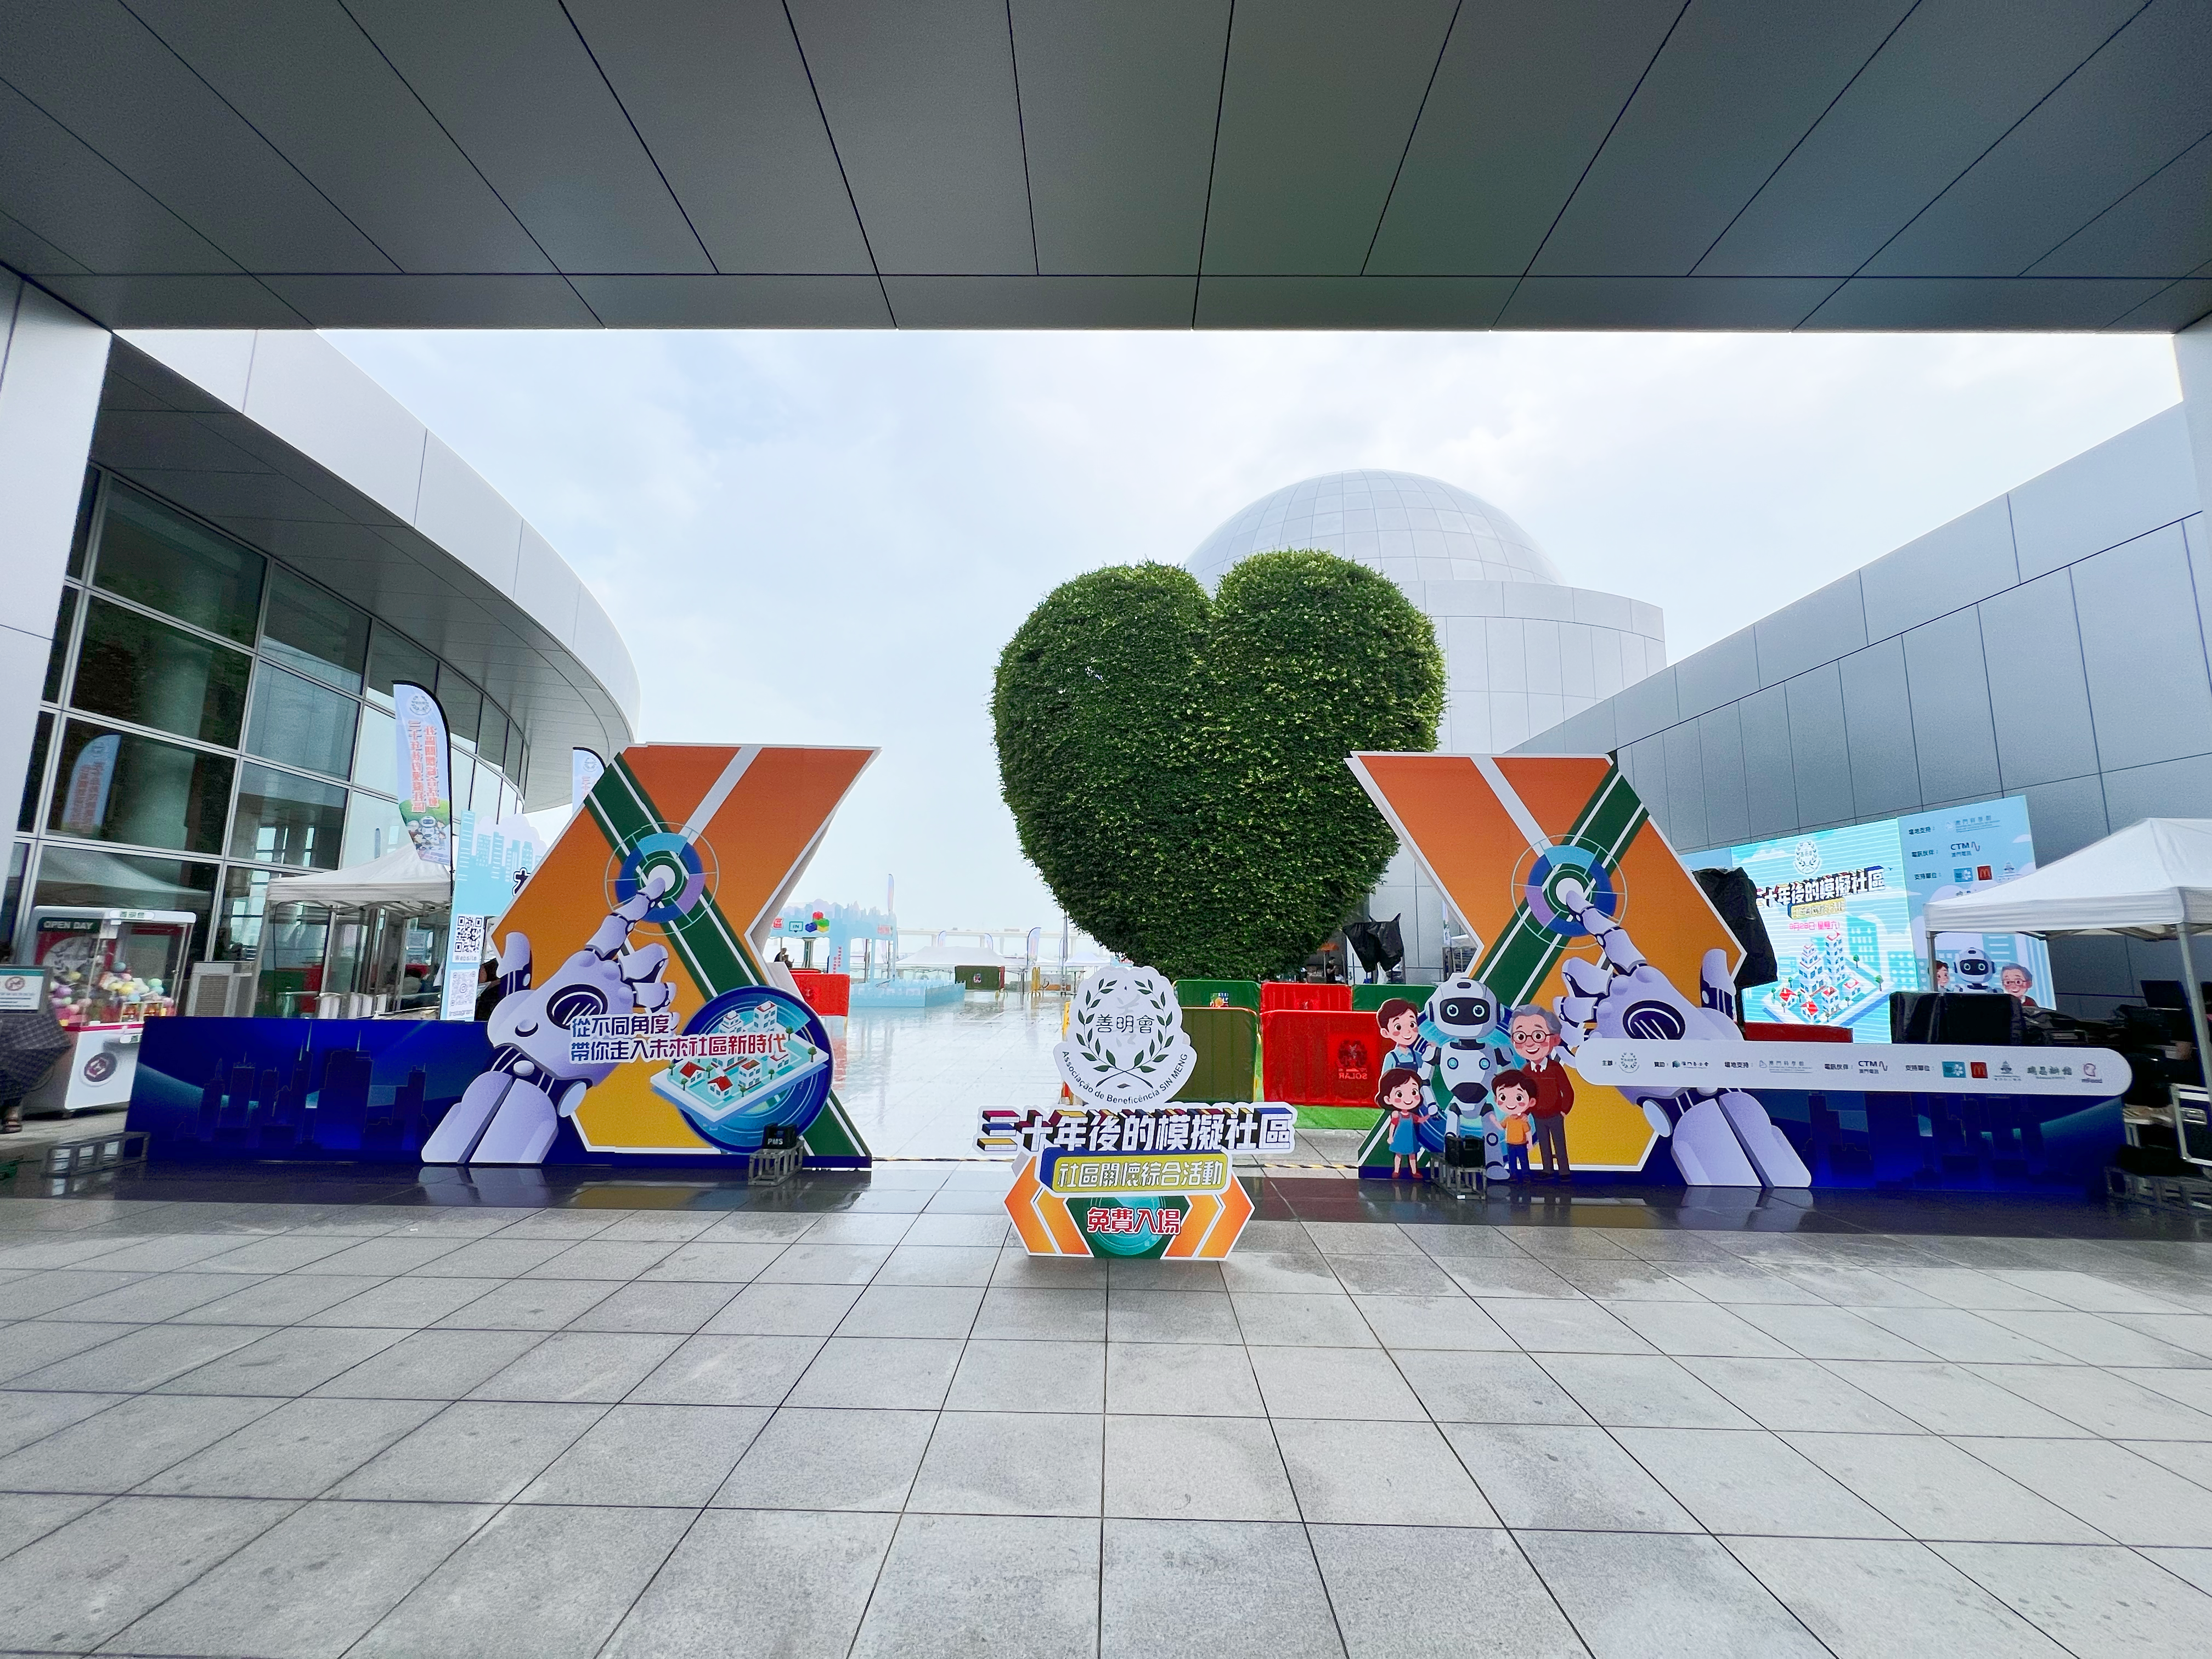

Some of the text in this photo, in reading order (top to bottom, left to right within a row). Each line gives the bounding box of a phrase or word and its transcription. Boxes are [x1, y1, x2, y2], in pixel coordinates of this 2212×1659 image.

[1950, 842, 1970, 850] CTM
[43, 921, 94, 930] OPEN DAY
[572, 1014, 670, 1037] 從不同角度
[1096, 1013, 1155, 1034] 善明會
[571, 1033, 788, 1061] 帶你走入未來社區新時代
[1062, 1051, 1188, 1104] Associação de Beneficência SIN MENG
[977, 1107, 1294, 1152] 三十年後的模擬社區
[1057, 1160, 1223, 1188] 社區關懷綜合活動
[1086, 1207, 1181, 1235] 免費入場
